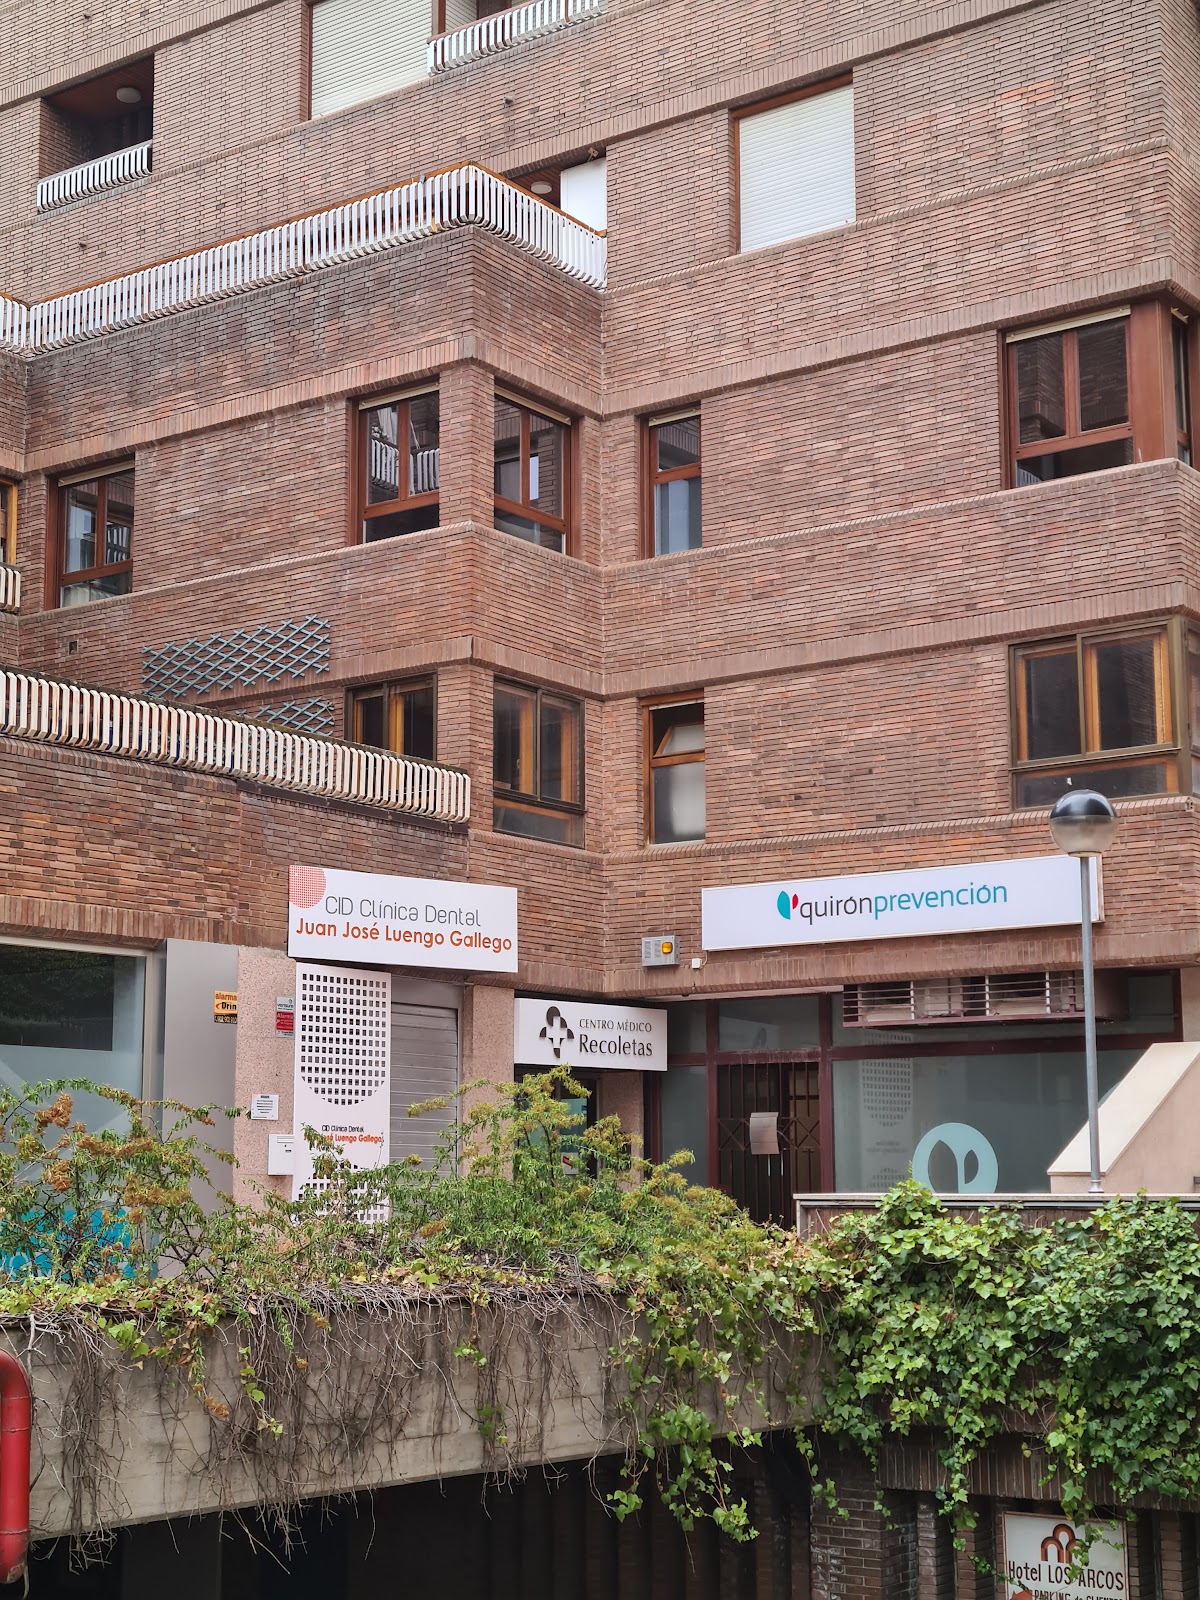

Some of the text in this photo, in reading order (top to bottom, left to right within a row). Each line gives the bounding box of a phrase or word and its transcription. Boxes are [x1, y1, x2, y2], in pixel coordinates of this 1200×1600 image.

[325, 895, 481, 927] CID Clínica Dental
[799, 881, 1008, 925] quirónprevención
[296, 918, 513, 954] Juan José Luengo Gallego
[215, 992, 238, 1001] alarma
[579, 1018, 652, 1033] CENTRO MÉDICO
[579, 1033, 653, 1057] Recoletas
[321, 1124, 330, 1132] CID
[348, 1125, 364, 1133] Dental
[334, 1133, 357, 1144] Luengo
[358, 1134, 382, 1145] Gallego
[1008, 1560, 1124, 1591] Hotel LOS ARCOS
